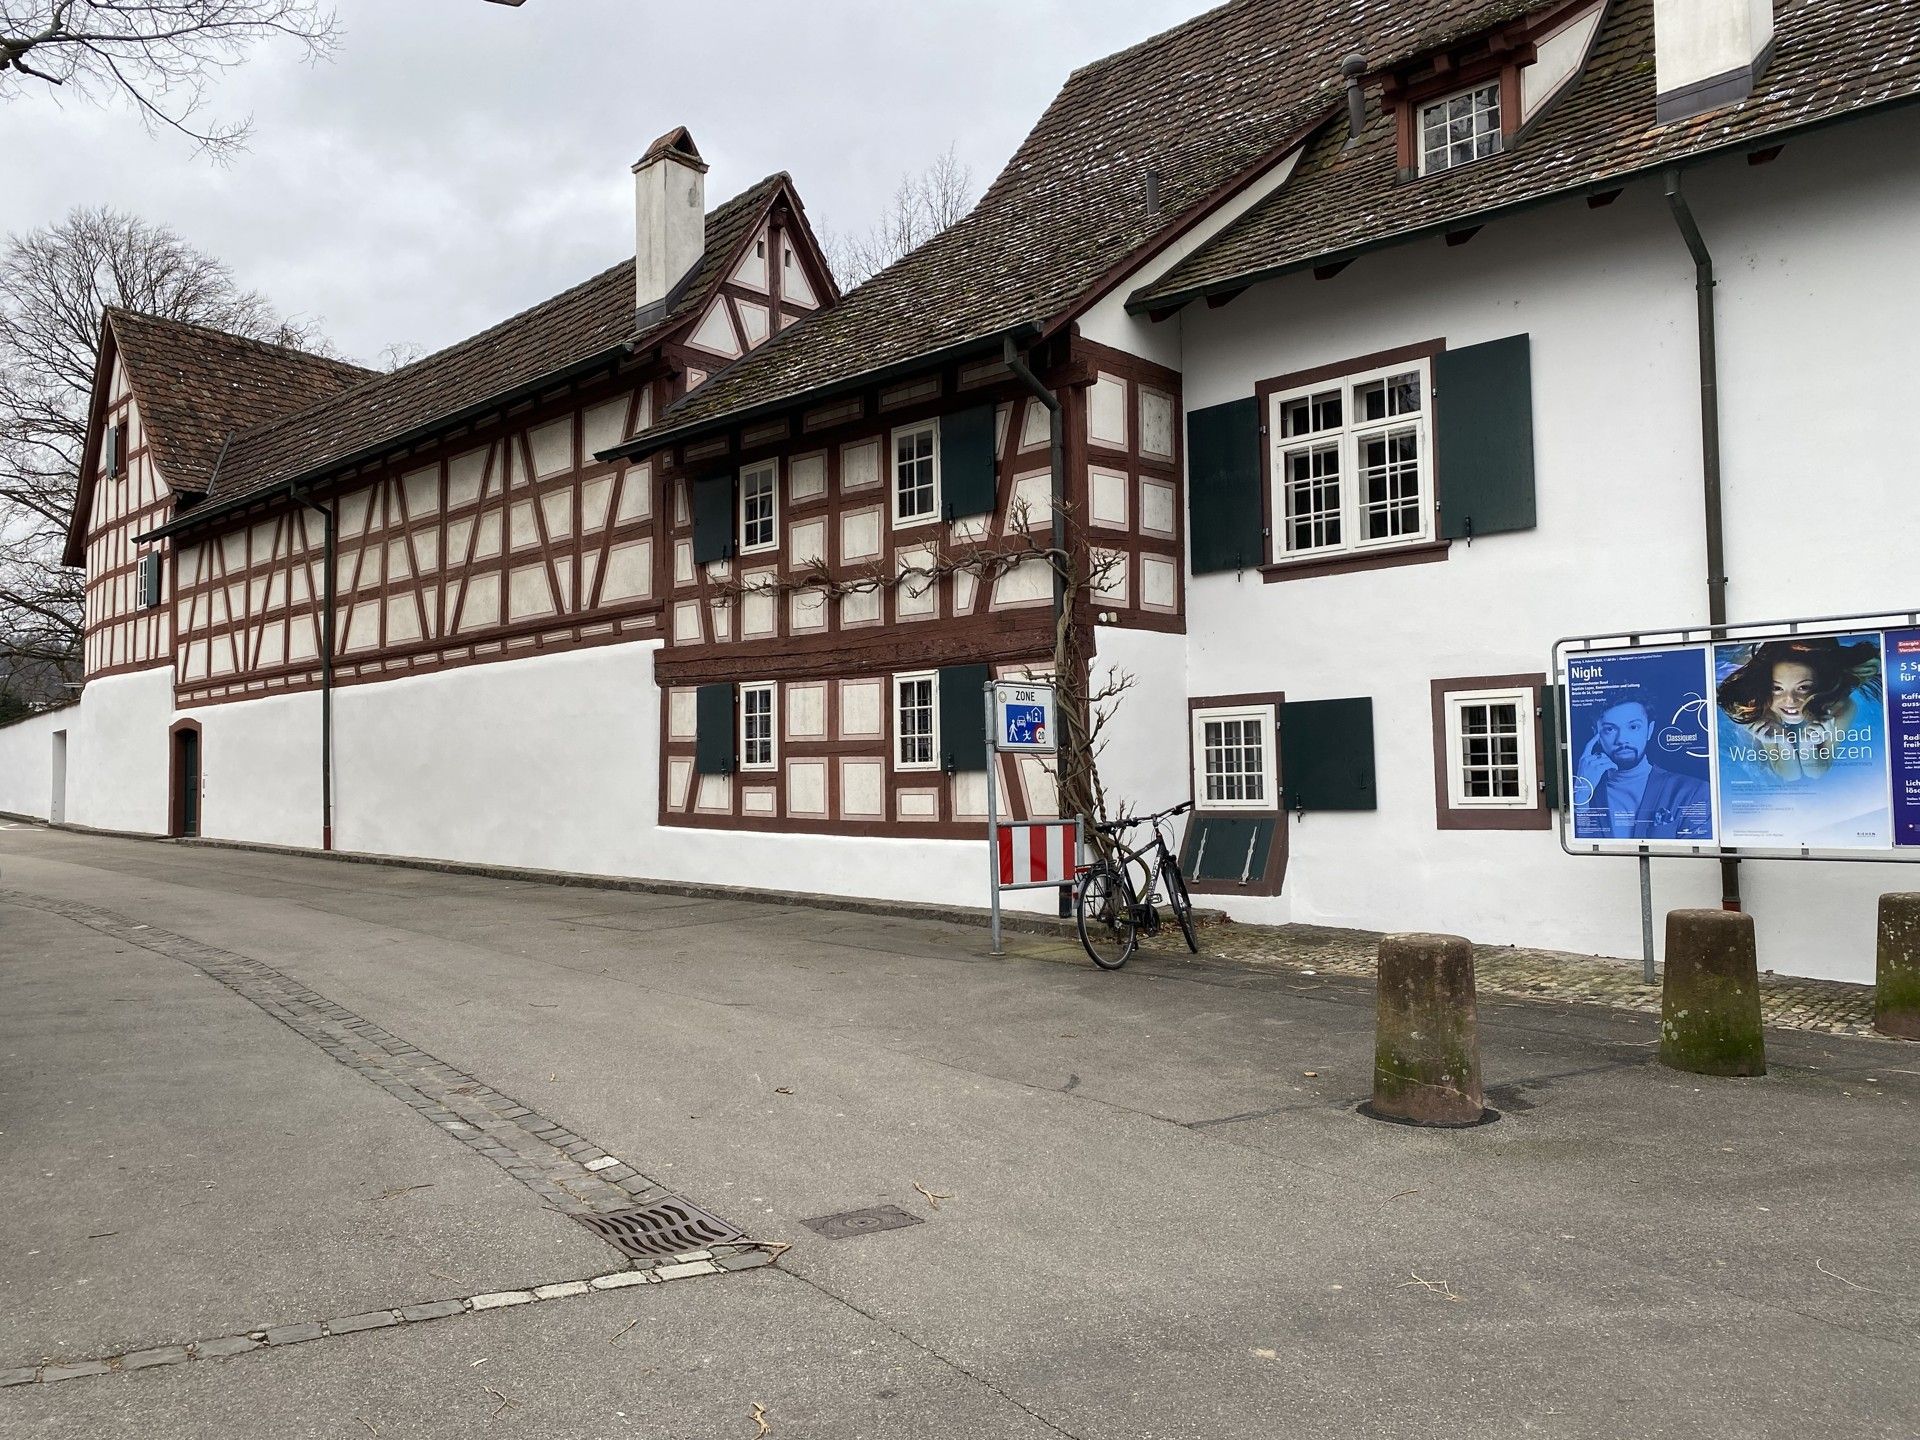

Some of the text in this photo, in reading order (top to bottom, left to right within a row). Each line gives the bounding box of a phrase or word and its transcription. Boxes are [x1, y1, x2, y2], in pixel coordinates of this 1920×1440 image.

[1900, 662, 1907, 670] 5
[1571, 666, 1603, 681] Night
[1900, 673, 1916, 681] für
[1015, 690, 1035, 701] ZONE
[1666, 733, 1697, 742] Classiques!
[1773, 724, 1871, 744] Hallenbad
[1729, 743, 1873, 762] Wasserstelzen
